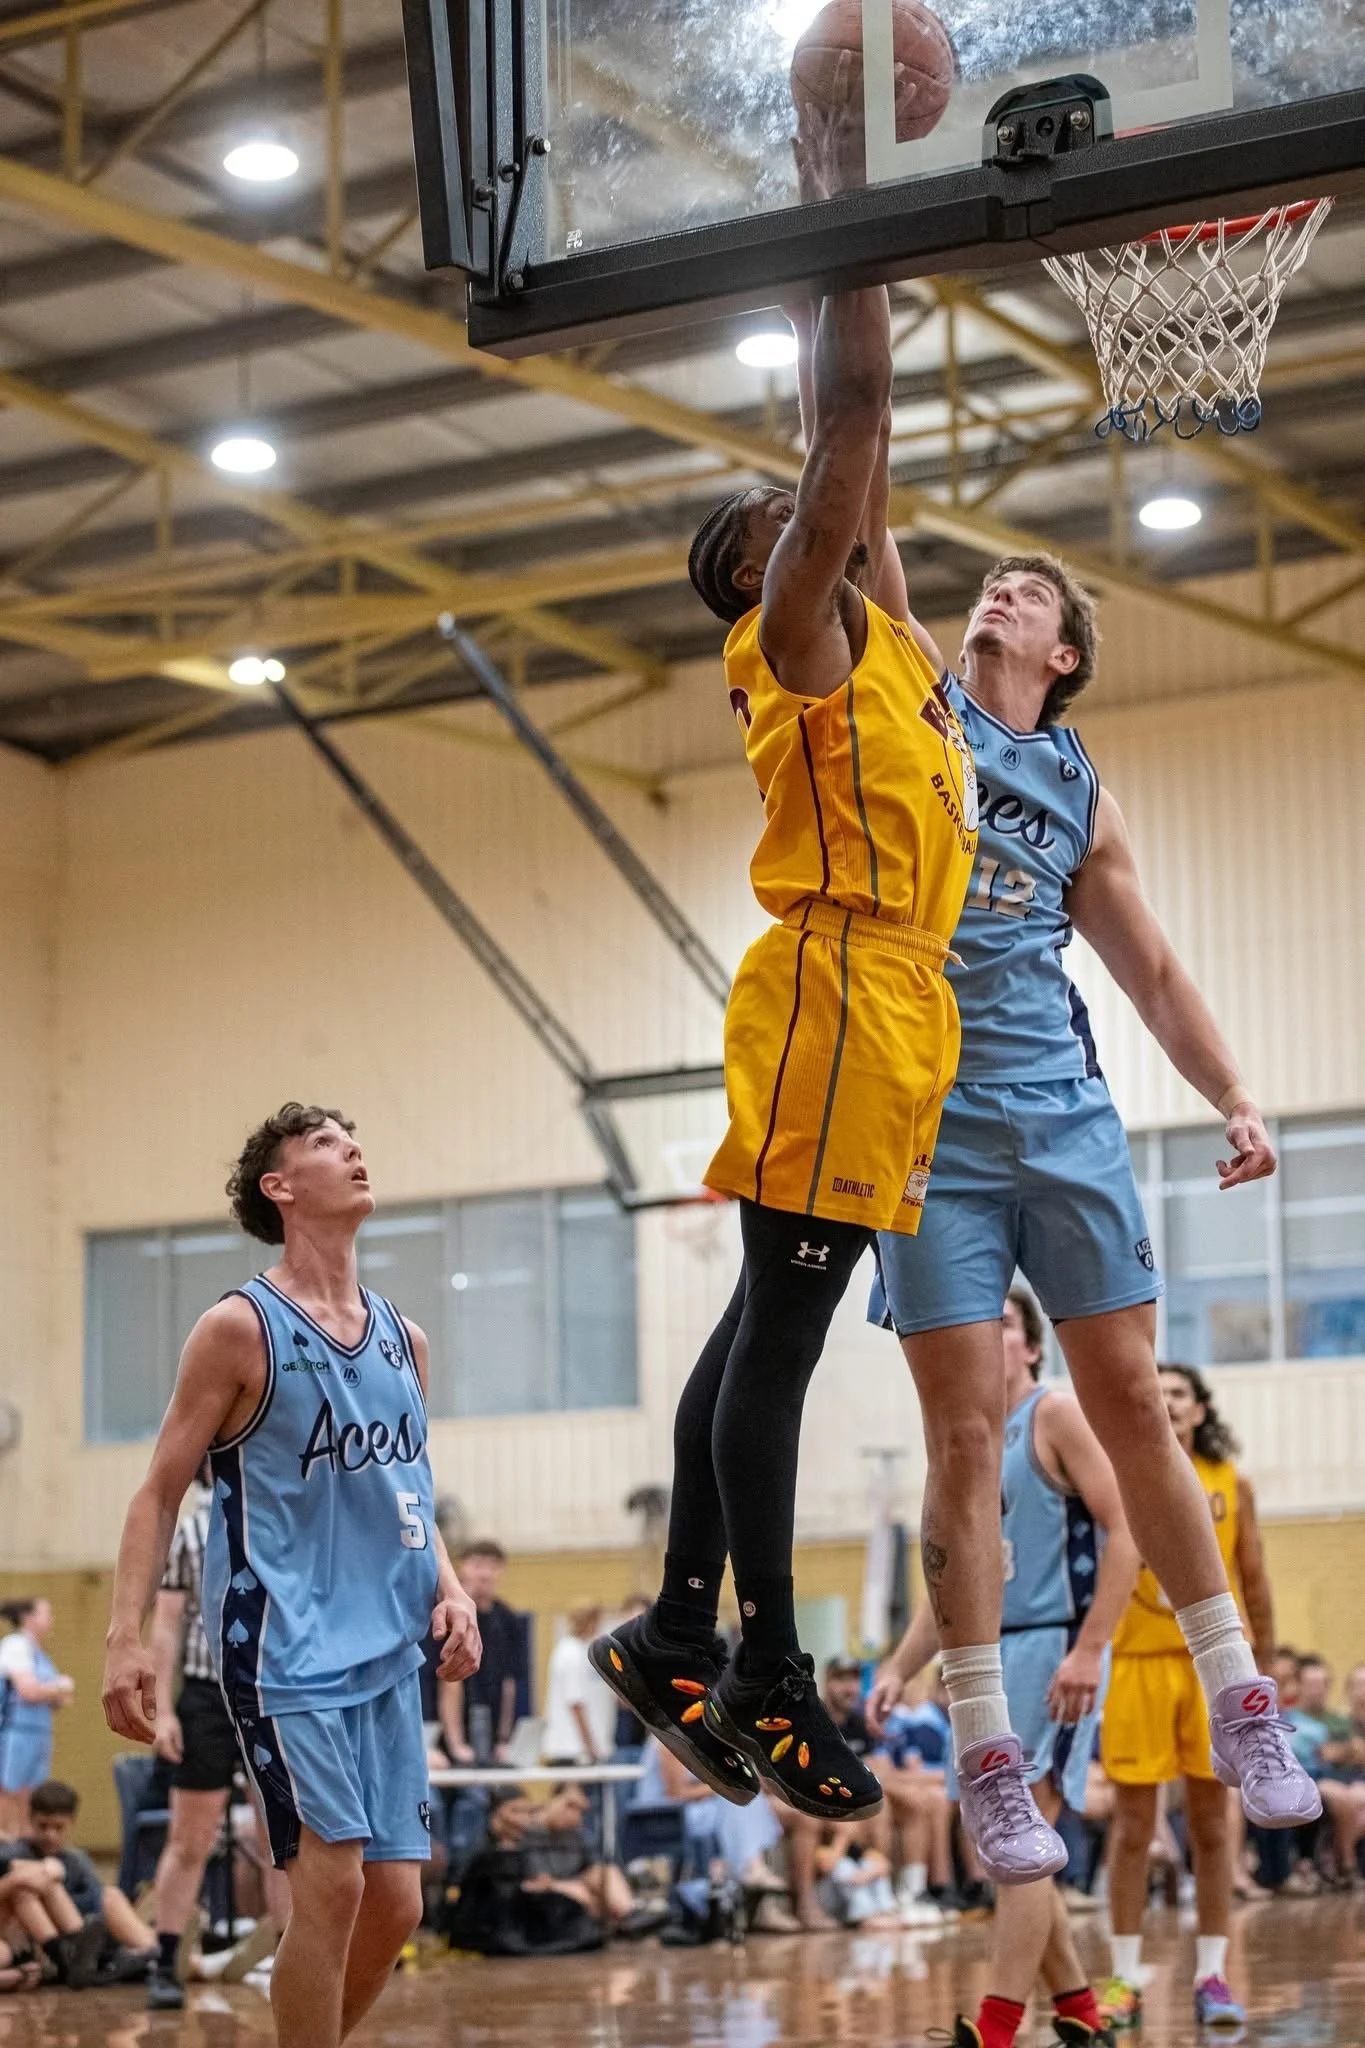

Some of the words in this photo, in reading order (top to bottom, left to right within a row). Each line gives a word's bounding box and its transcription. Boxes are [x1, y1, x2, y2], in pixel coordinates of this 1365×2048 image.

[931, 773, 977, 856] BASKEBALL
[967, 856, 1037, 922] 12
[841, 1180, 875, 1199] ATHLETIC
[299, 1398, 423, 1481] Aces
[396, 1491, 428, 1550] 5
